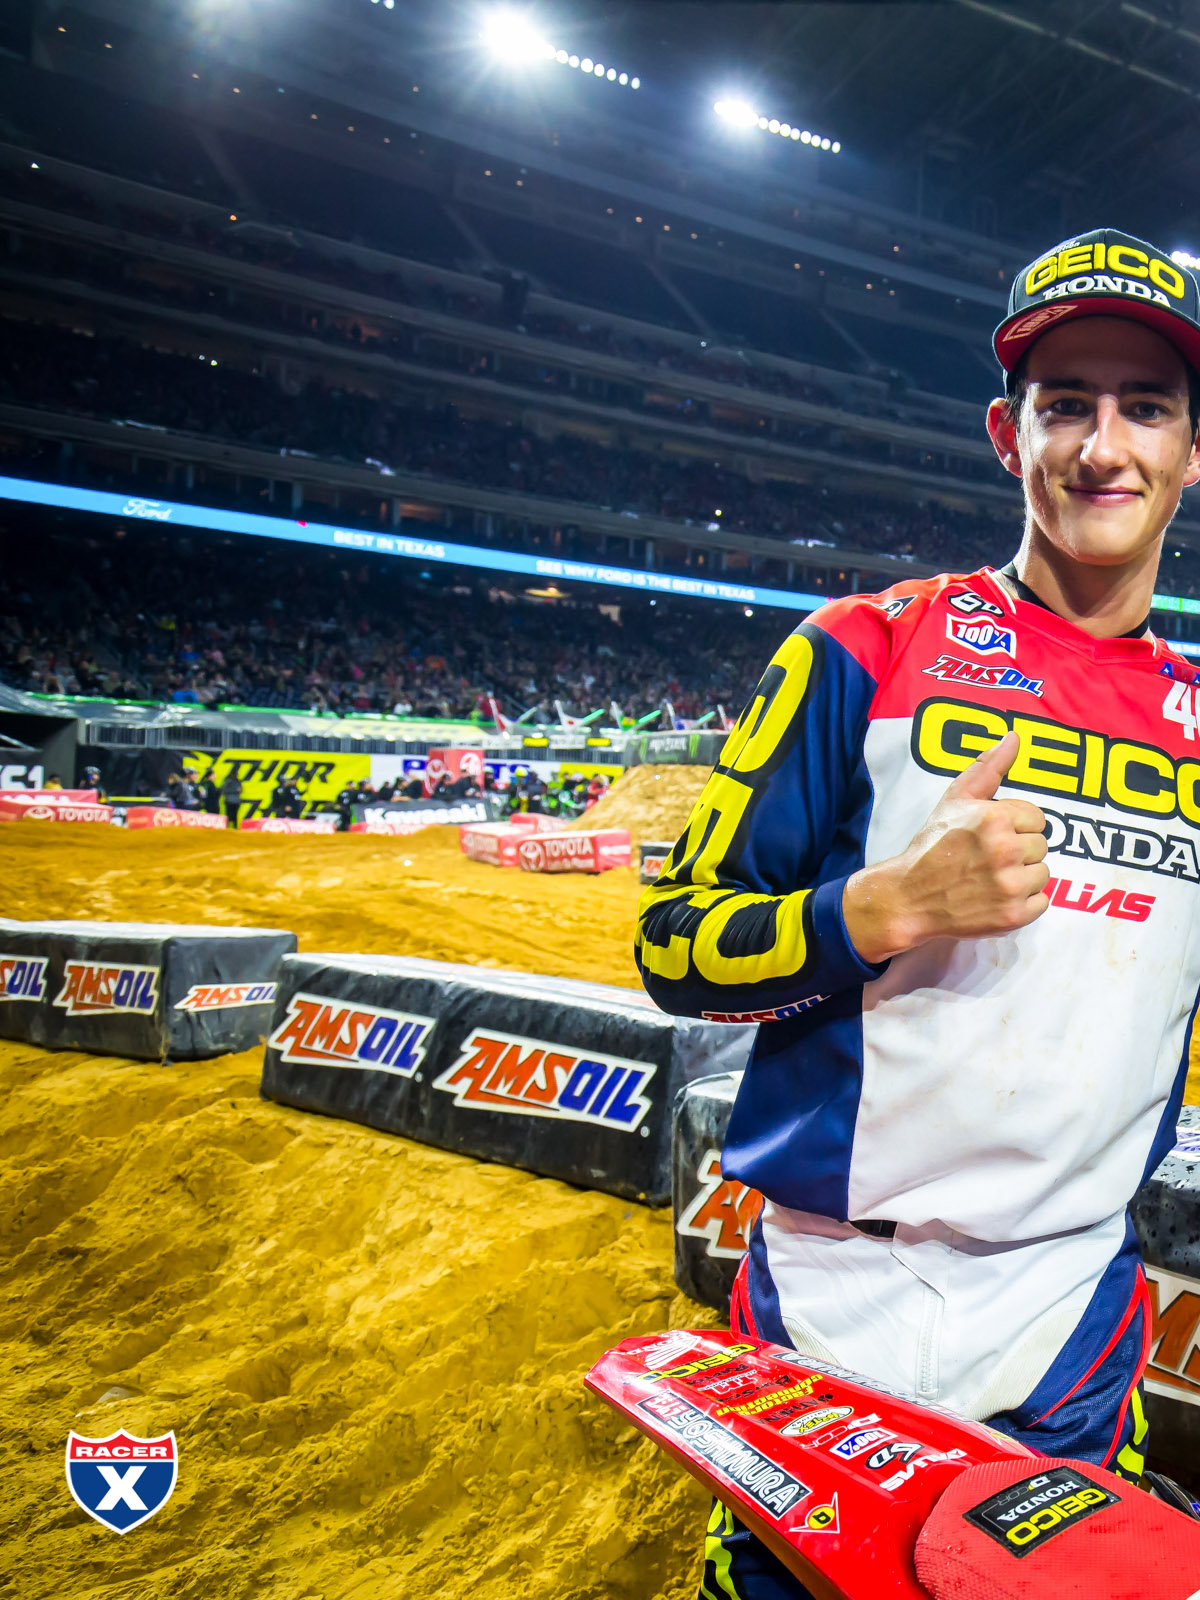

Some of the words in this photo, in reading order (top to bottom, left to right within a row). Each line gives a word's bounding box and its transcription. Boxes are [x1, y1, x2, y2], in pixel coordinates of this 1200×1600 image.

[1025, 243, 1184, 299] GEICO
[1043, 275, 1171, 308] HONDA
[122, 498, 172, 521] Ford
[333, 530, 373, 548] BEST
[376, 536, 394, 551] IN
[395, 538, 445, 558] TEXAS
[956, 624, 1007, 648] 100%
[926, 656, 1043, 697] AMSOIL
[224, 758, 335, 784] THOR
[57, 807, 110, 823] TOYOTA
[364, 803, 487, 825] Kawasaki
[543, 837, 593, 857] TOYOTA
[1044, 810, 1200, 882] ONDA
[60, 964, 157, 1012] AMSOIL
[275, 999, 428, 1072] AMSOIL
[446, 1035, 647, 1124] AMSOIL
[751, 1399, 819, 1425] ATHENA
[840, 1430, 885, 1454] 100%
[667, 1407, 802, 1514] YOSHIMURA
[996, 1481, 1080, 1522] HONDA
[1005, 1488, 1107, 1546] GEICO
